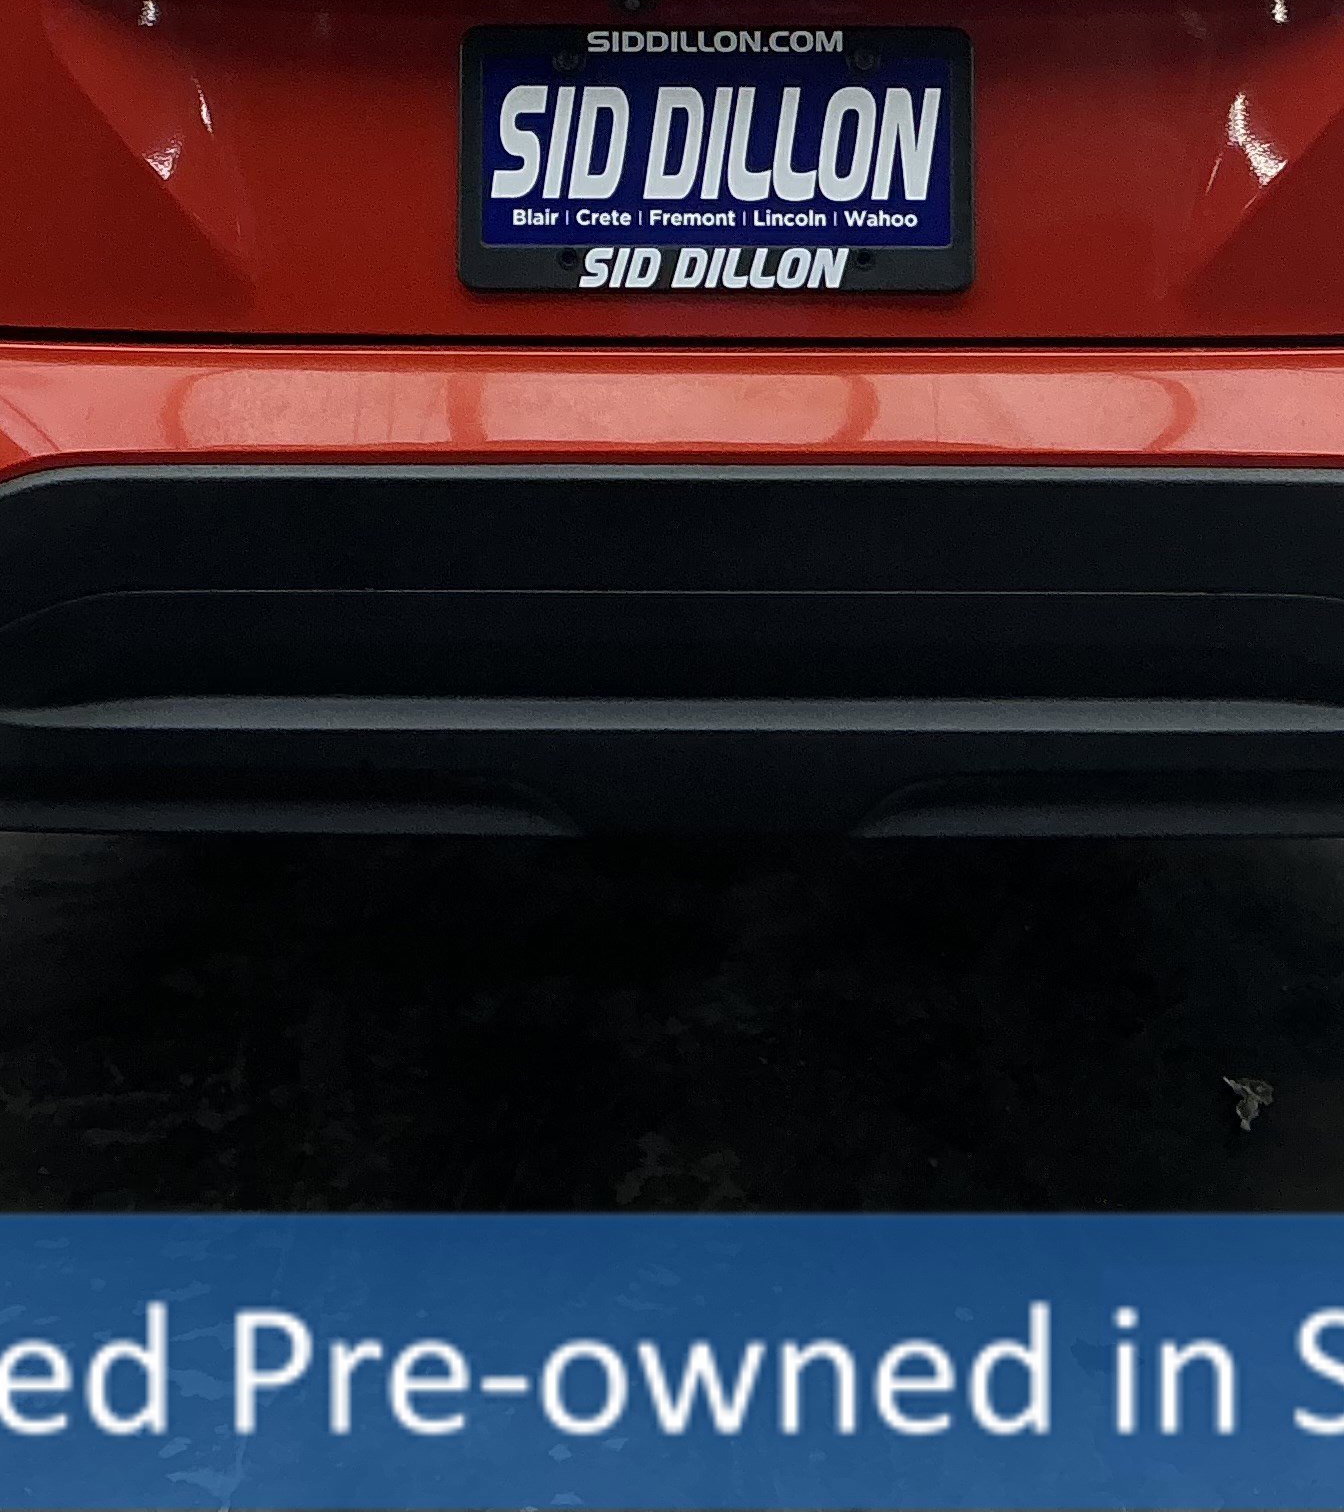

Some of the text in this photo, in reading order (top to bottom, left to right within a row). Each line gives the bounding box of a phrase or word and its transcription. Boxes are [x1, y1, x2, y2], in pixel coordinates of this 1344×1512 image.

[586, 30, 844, 54] SIDDILLON.COM
[490, 84, 942, 202] SID DILLON
[512, 207, 919, 228] Blair Crete Fremont Lincoln Wahoo
[578, 246, 850, 290] SID DILLON
